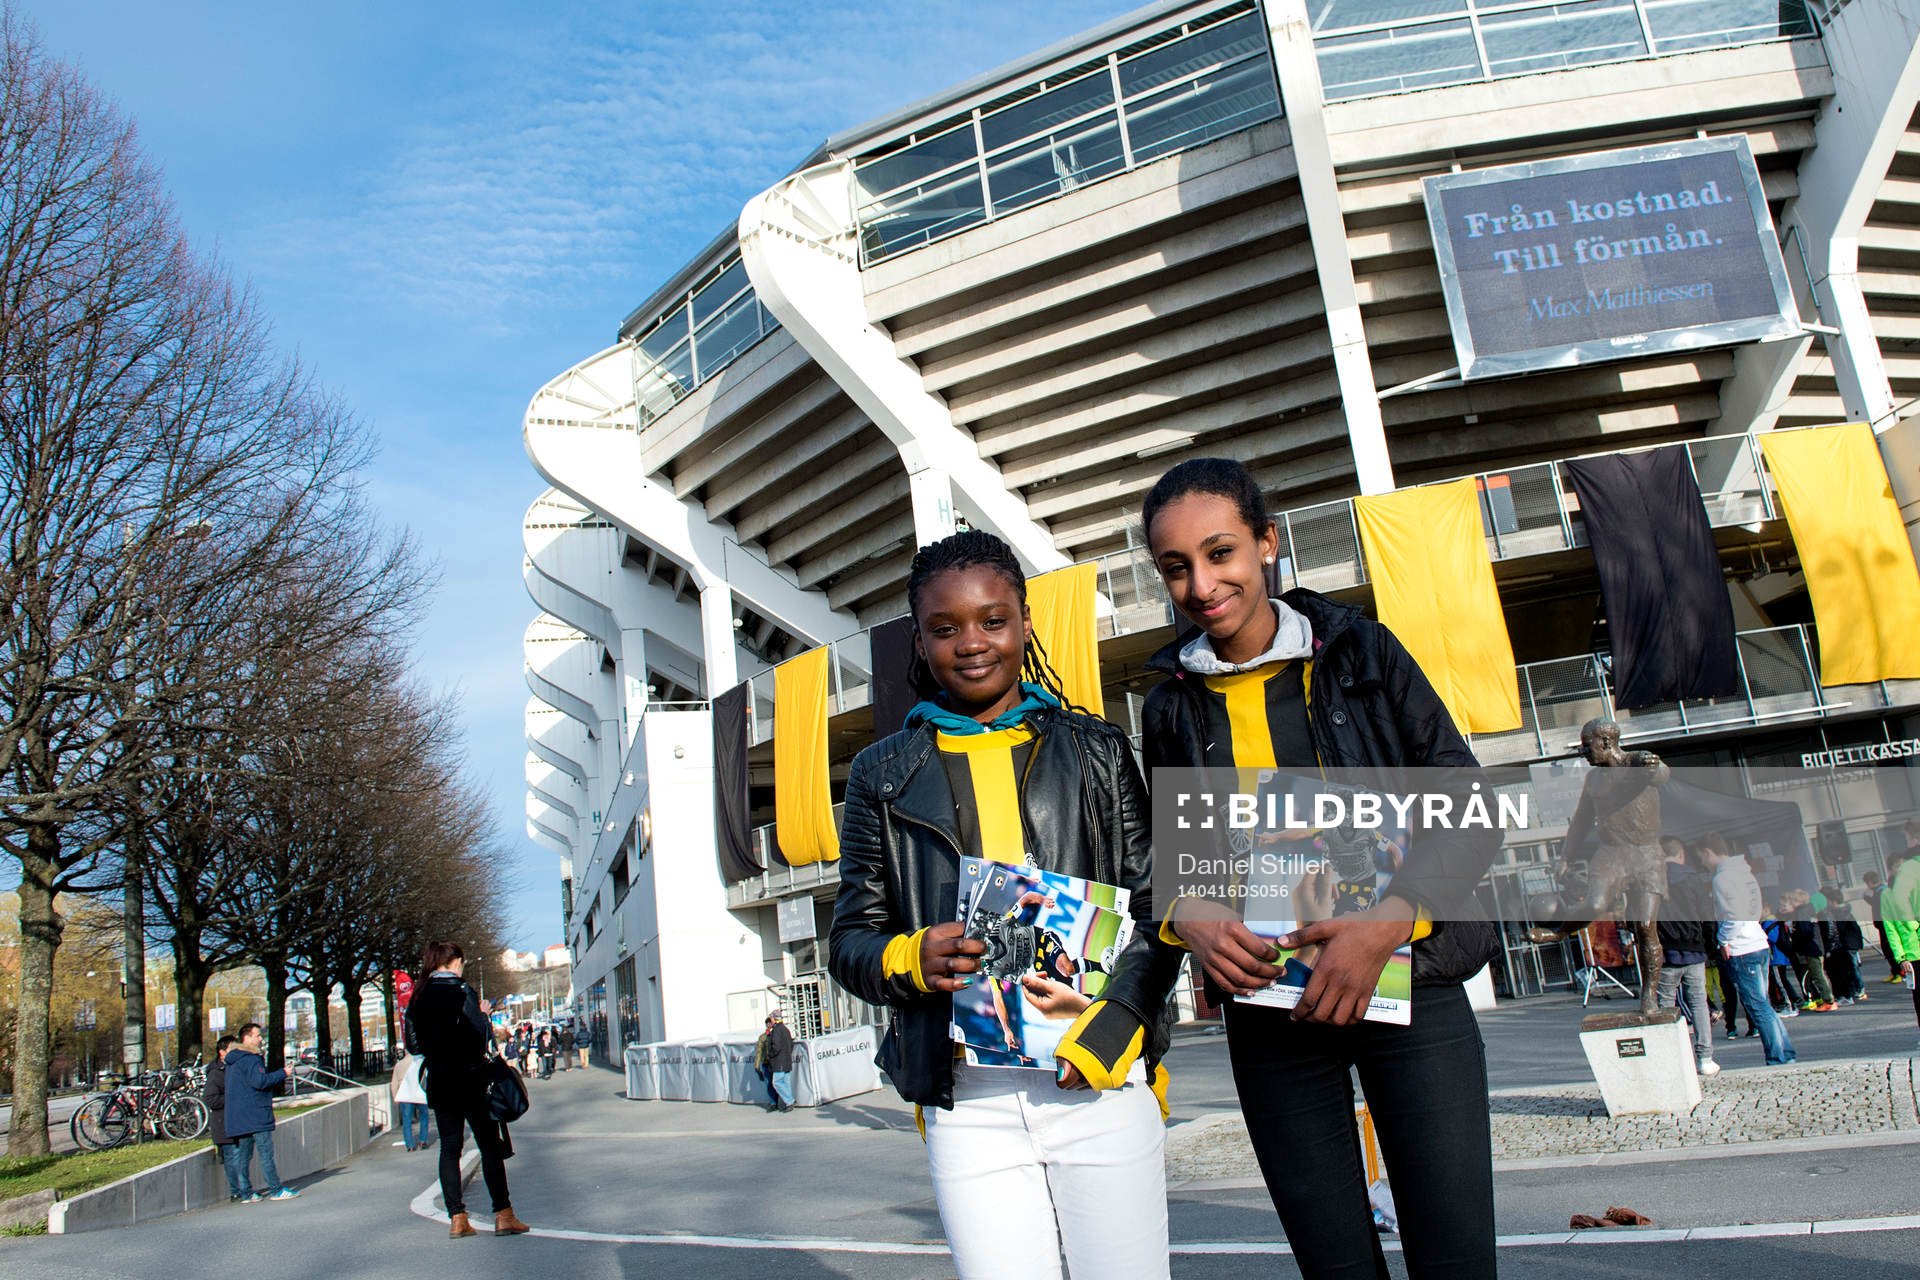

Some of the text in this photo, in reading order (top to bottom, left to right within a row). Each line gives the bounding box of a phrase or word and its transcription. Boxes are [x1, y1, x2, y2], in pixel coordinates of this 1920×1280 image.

[1463, 180, 1733, 239] Från kostnad.
[1493, 223, 1725, 275] Till förmån.
[1526, 278, 1715, 322] Max Matthiessen
[816, 1048, 841, 1060] GAMLA
[846, 1041, 871, 1054] ULLEVI
